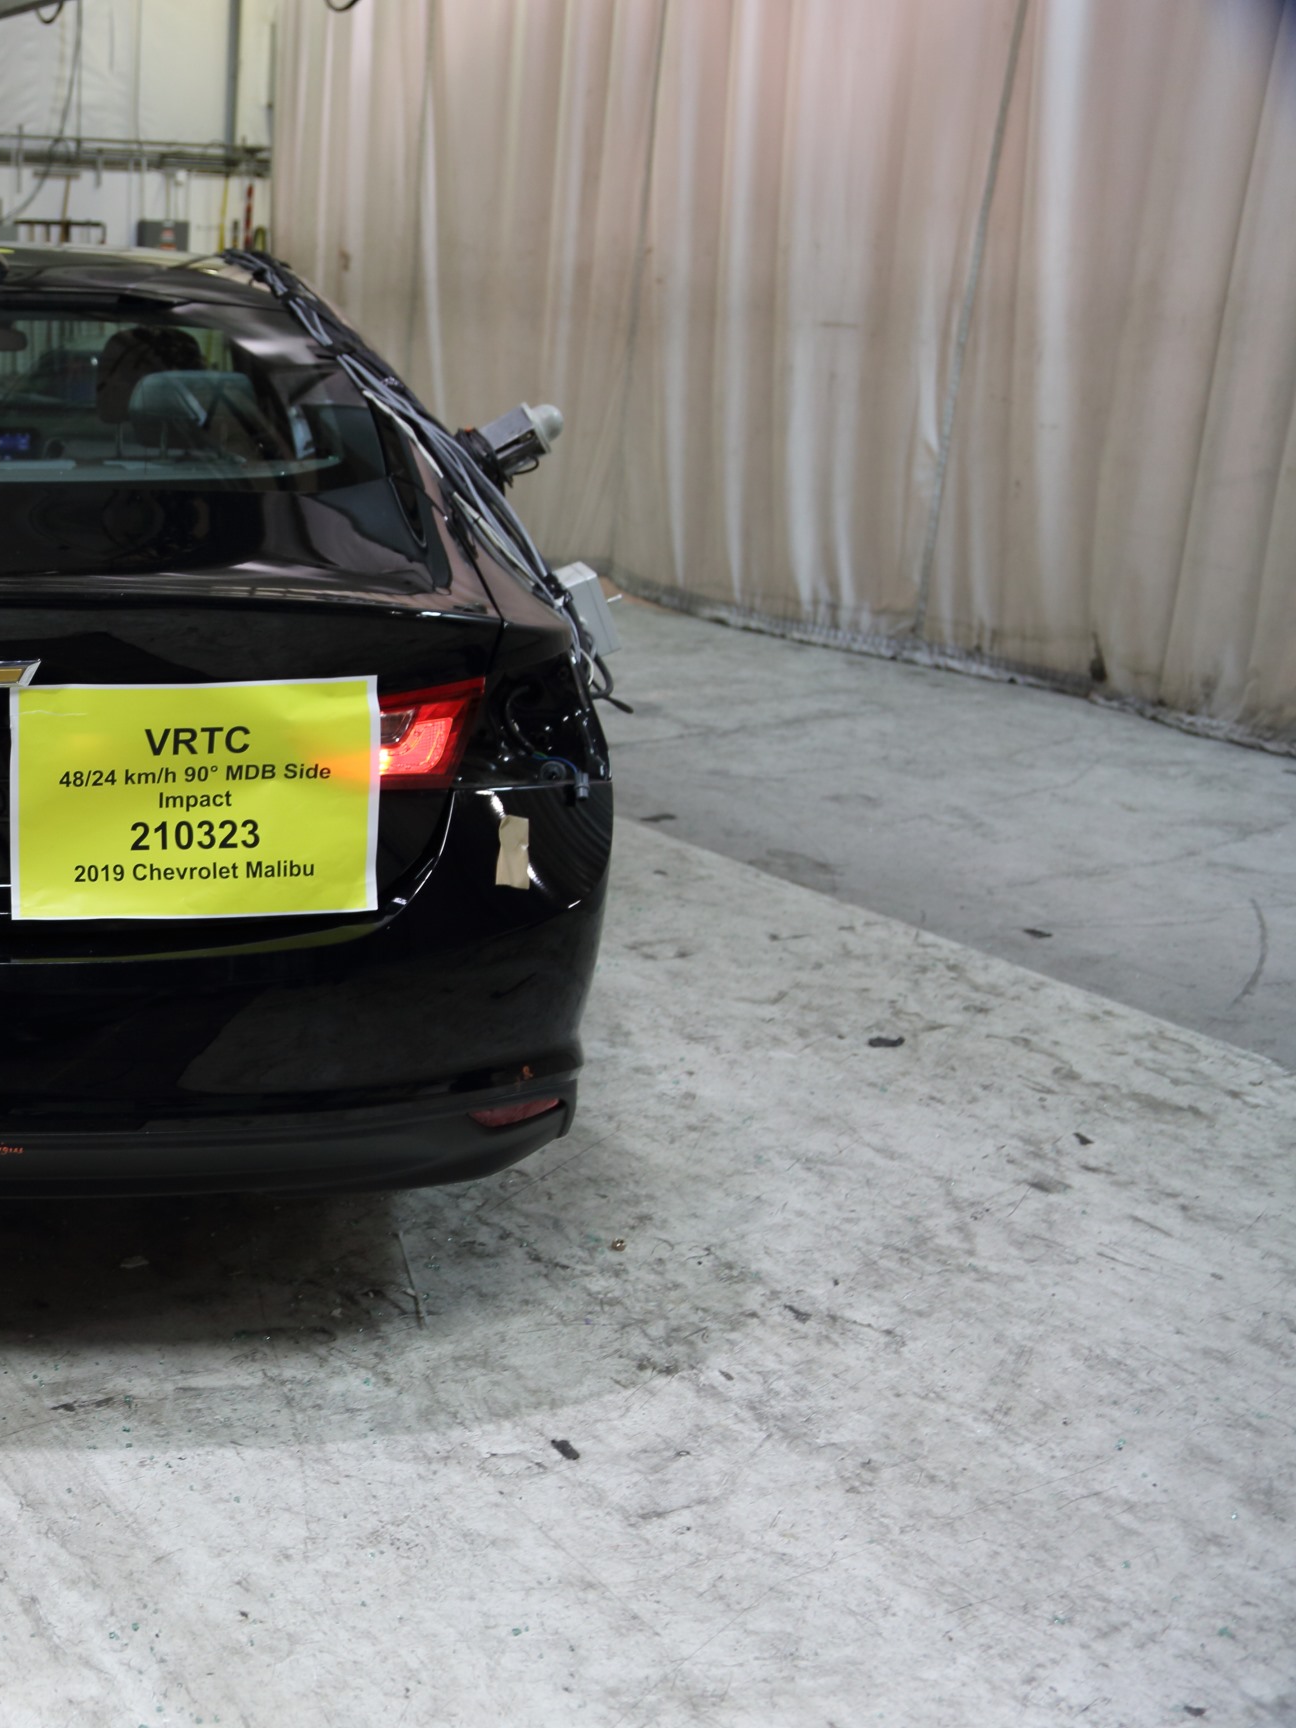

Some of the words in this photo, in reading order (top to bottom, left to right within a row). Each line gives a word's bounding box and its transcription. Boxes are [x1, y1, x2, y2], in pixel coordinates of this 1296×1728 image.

[145, 726, 250, 756] VRTC
[59, 770, 116, 787] 48/24
[125, 768, 176, 784] km/h
[185, 766, 218, 782] 90°
[226, 764, 275, 780] MDB
[284, 763, 330, 779] Side
[160, 791, 231, 811] Impact
[131, 820, 259, 850] 210323
[75, 865, 124, 882] 2019
[133, 863, 238, 880] Chevrolet
[247, 861, 314, 878] Malibu
